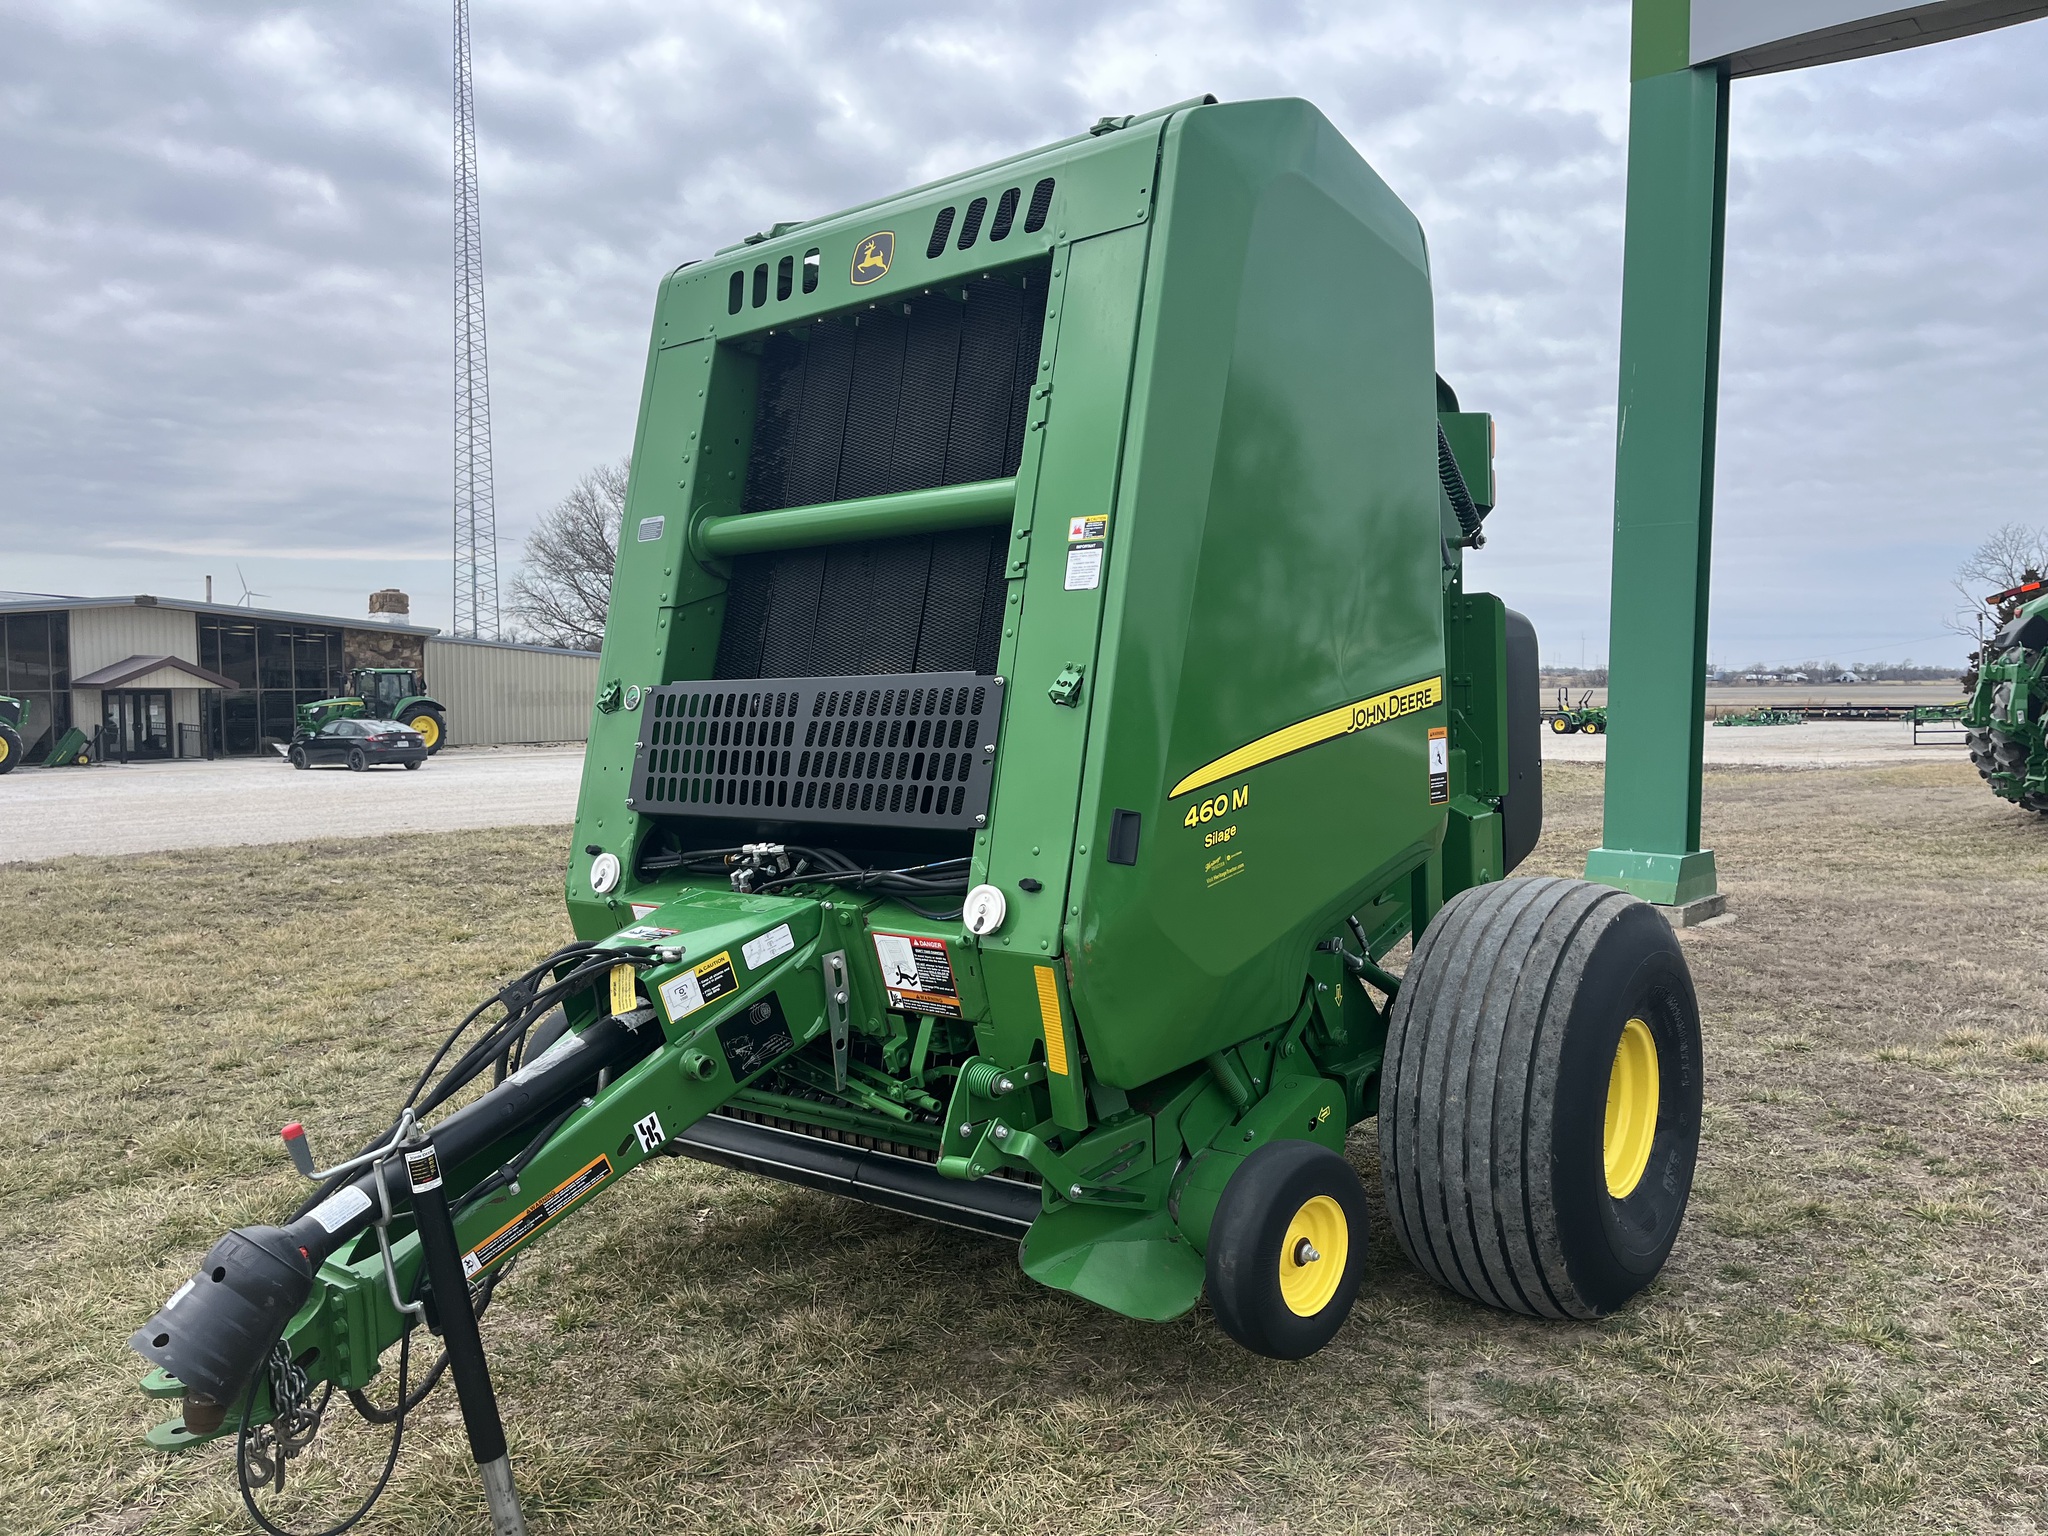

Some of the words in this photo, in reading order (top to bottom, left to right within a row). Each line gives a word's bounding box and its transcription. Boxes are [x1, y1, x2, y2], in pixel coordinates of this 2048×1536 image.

[1347, 702, 1387, 731] JOHN
[1389, 688, 1432, 717] DEERE
[1184, 793, 1229, 829] 460
[1232, 783, 1249, 812] M
[1204, 825, 1237, 848] Silage
[919, 940, 942, 949] DANGER
[703, 956, 725, 971] CAUTION
[530, 1190, 556, 1210] WARNING
